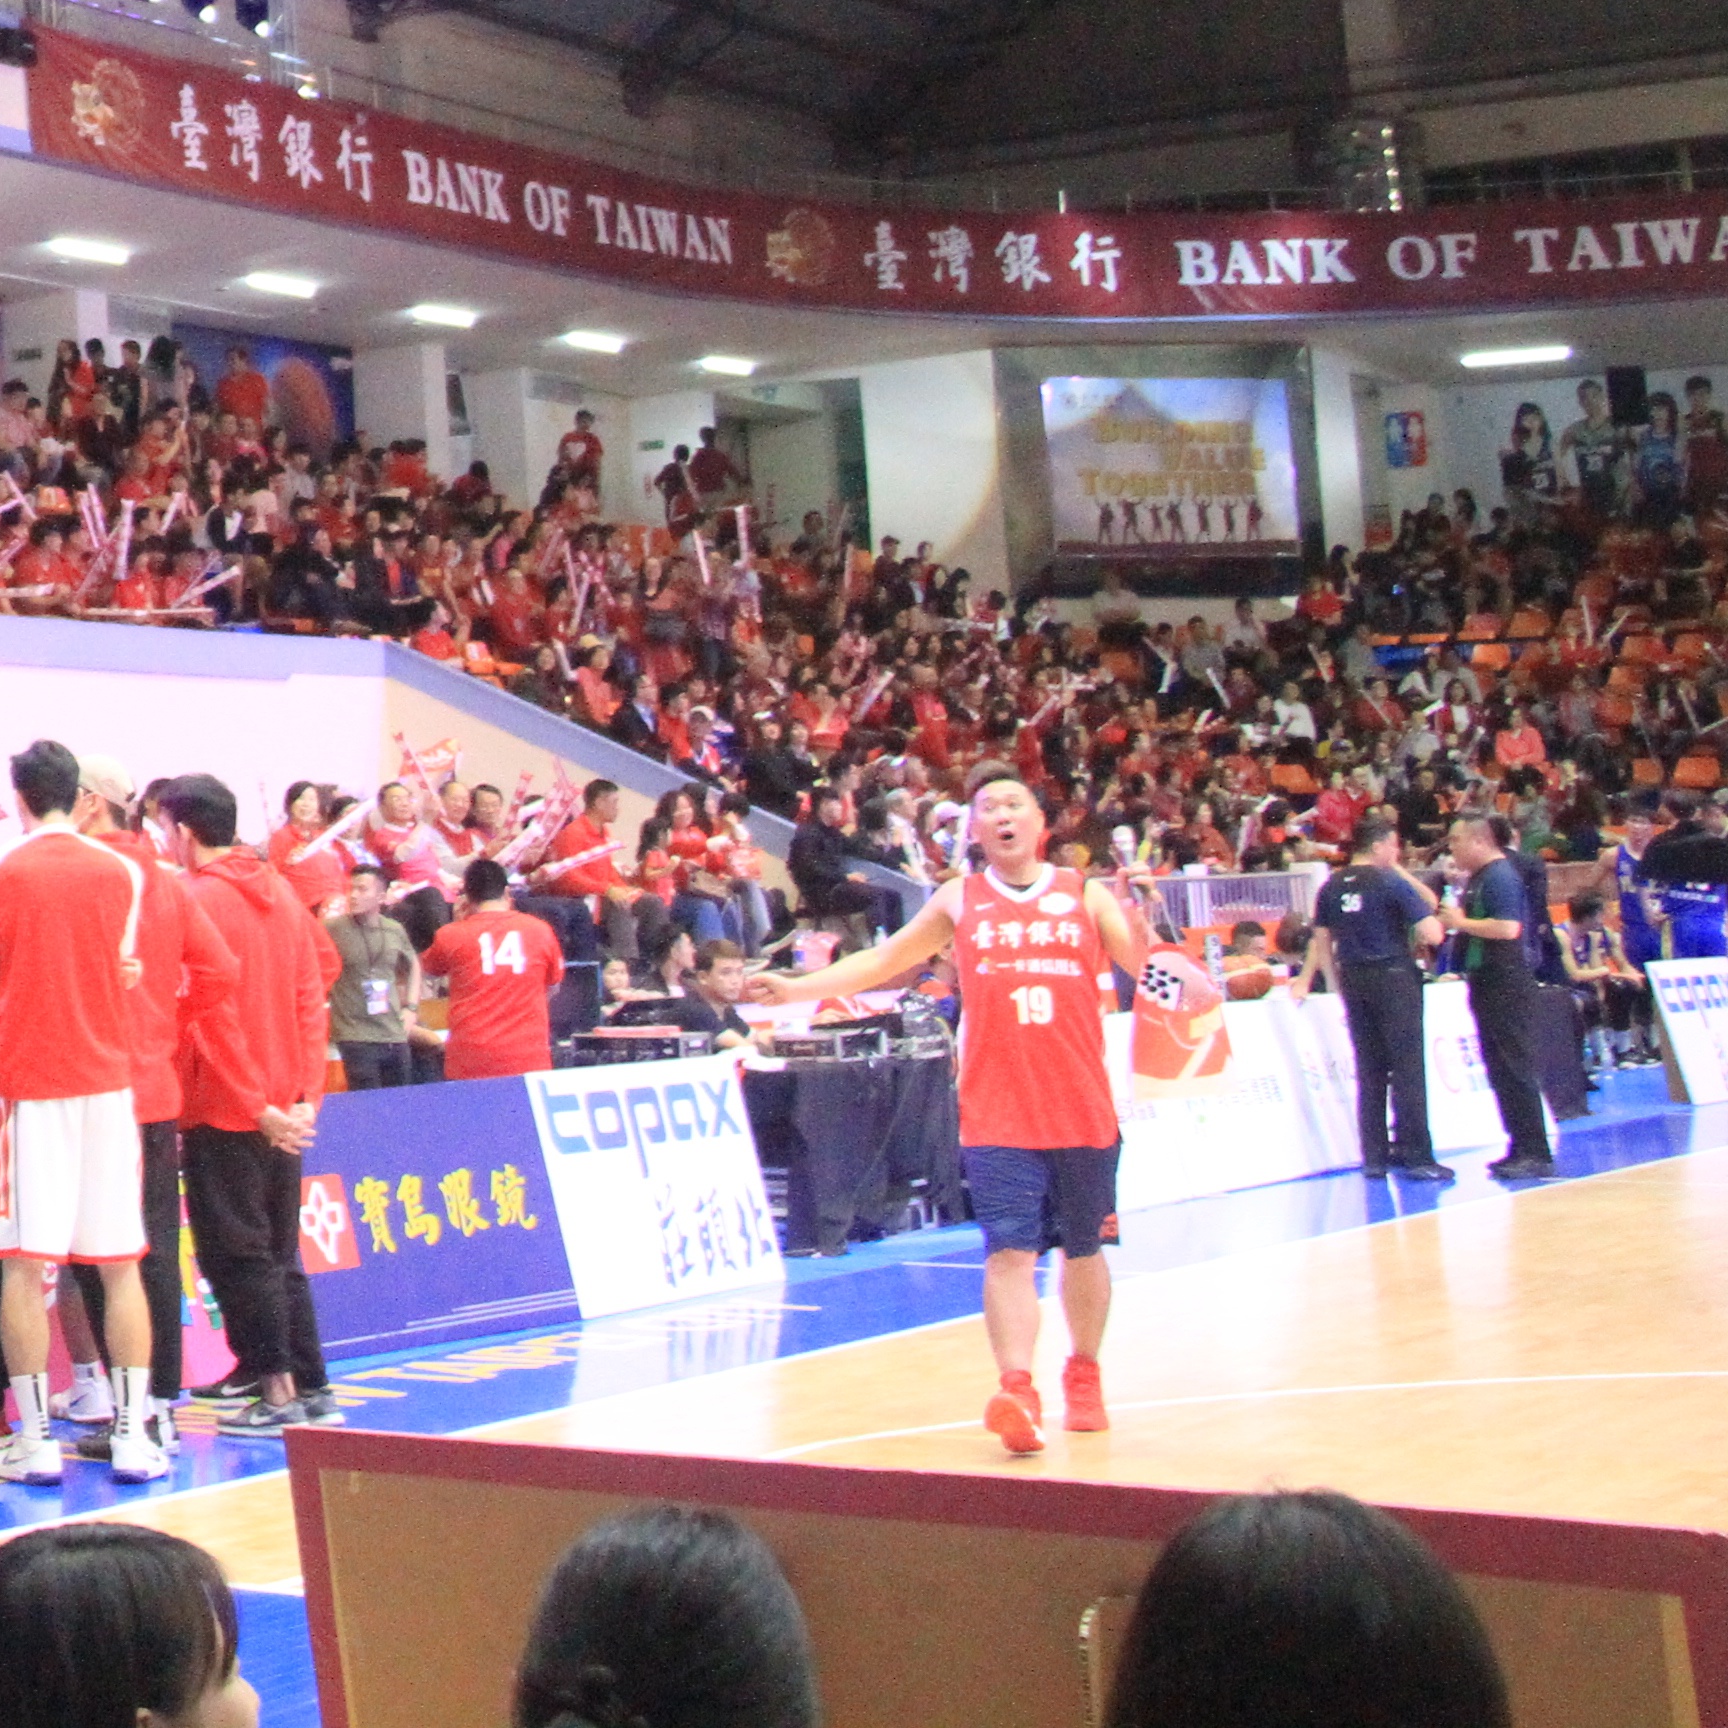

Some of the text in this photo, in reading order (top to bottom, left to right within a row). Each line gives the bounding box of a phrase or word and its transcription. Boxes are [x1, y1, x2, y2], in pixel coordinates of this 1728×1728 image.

[170, 83, 374, 203] 臺灣銀行
[402, 149, 510, 224] BANK
[523, 180, 570, 237] OF
[586, 195, 733, 265] TAIWAN
[863, 220, 1124, 295] 臺灣銀行
[1175, 237, 1356, 288] BANK
[1387, 231, 1477, 280] OF
[477, 930, 526, 974] 14
[1009, 985, 1053, 1024] 19
[538, 1079, 742, 1179] topax
[354, 1164, 538, 1254] 寶島眼鏡
